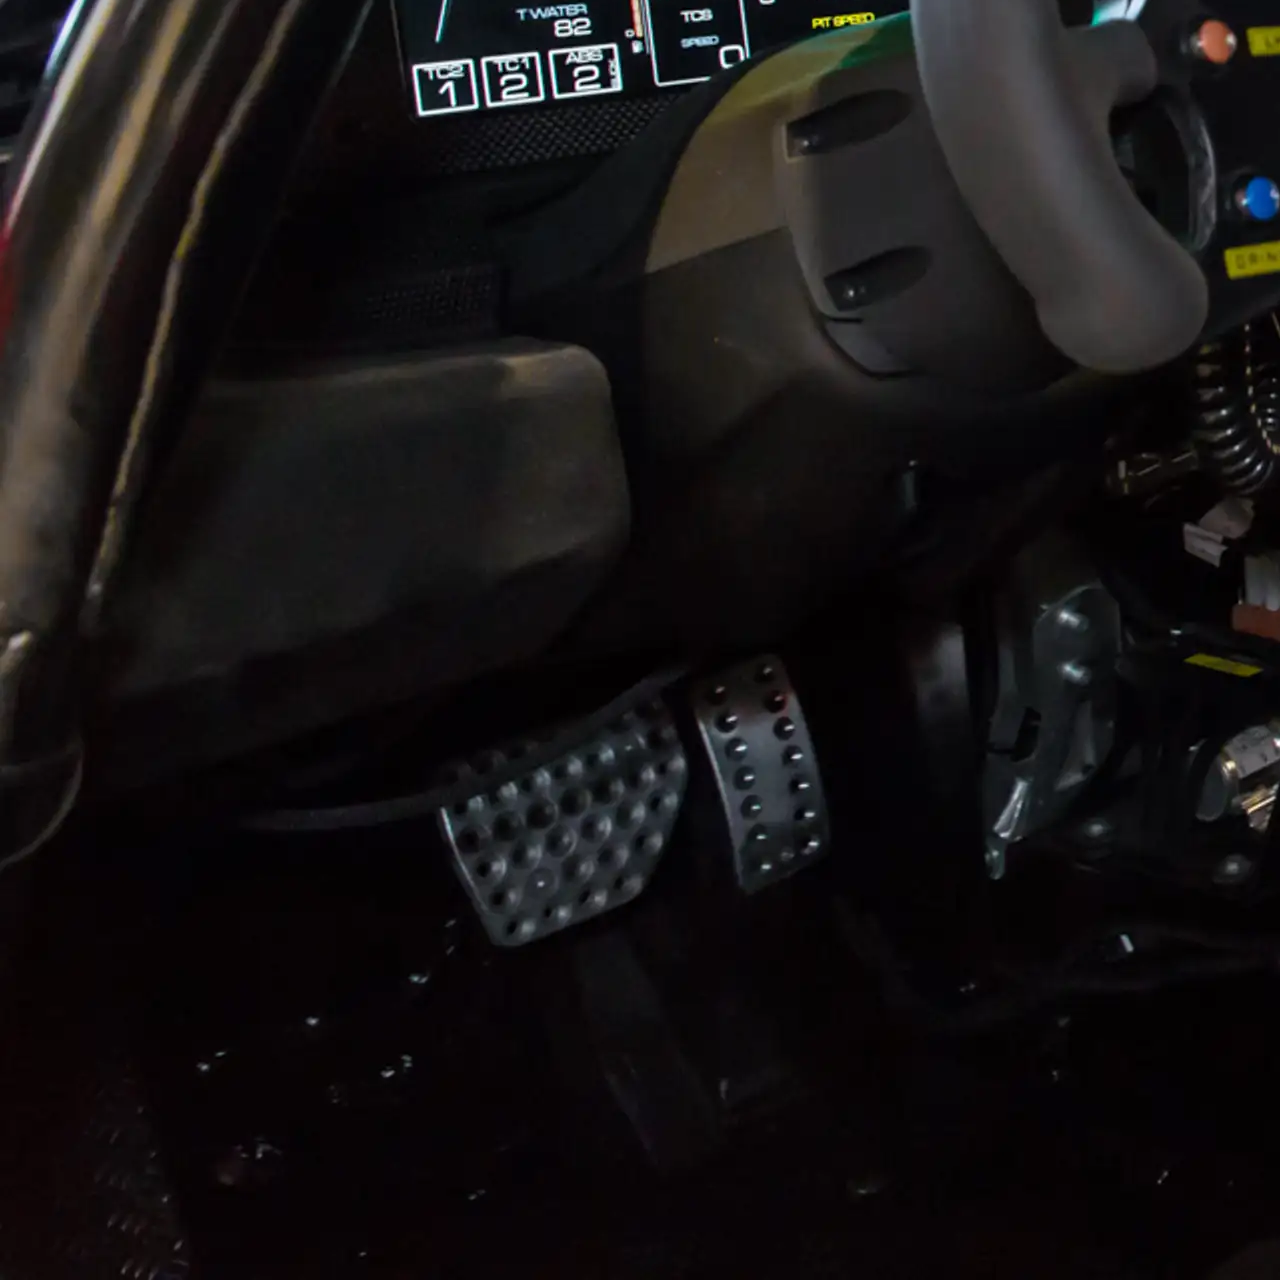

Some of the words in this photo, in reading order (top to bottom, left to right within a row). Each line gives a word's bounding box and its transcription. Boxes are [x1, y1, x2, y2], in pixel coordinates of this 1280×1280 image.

[516, 9, 529, 21] T
[528, 3, 588, 20] WATER
[680, 9, 714, 23] TCS
[811, 16, 831, 30] PIT
[831, 11, 875, 28] SPEED
[553, 17, 592, 38] 82
[680, 35, 720, 48] SPEED
[492, 57, 531, 74] TC1
[565, 48, 604, 66] ABS
[718, 44, 745, 70] 0
[424, 64, 466, 81] TC2
[572, 65, 602, 92] 2
[438, 81, 457, 108] 1
[499, 74, 530, 100] 2
